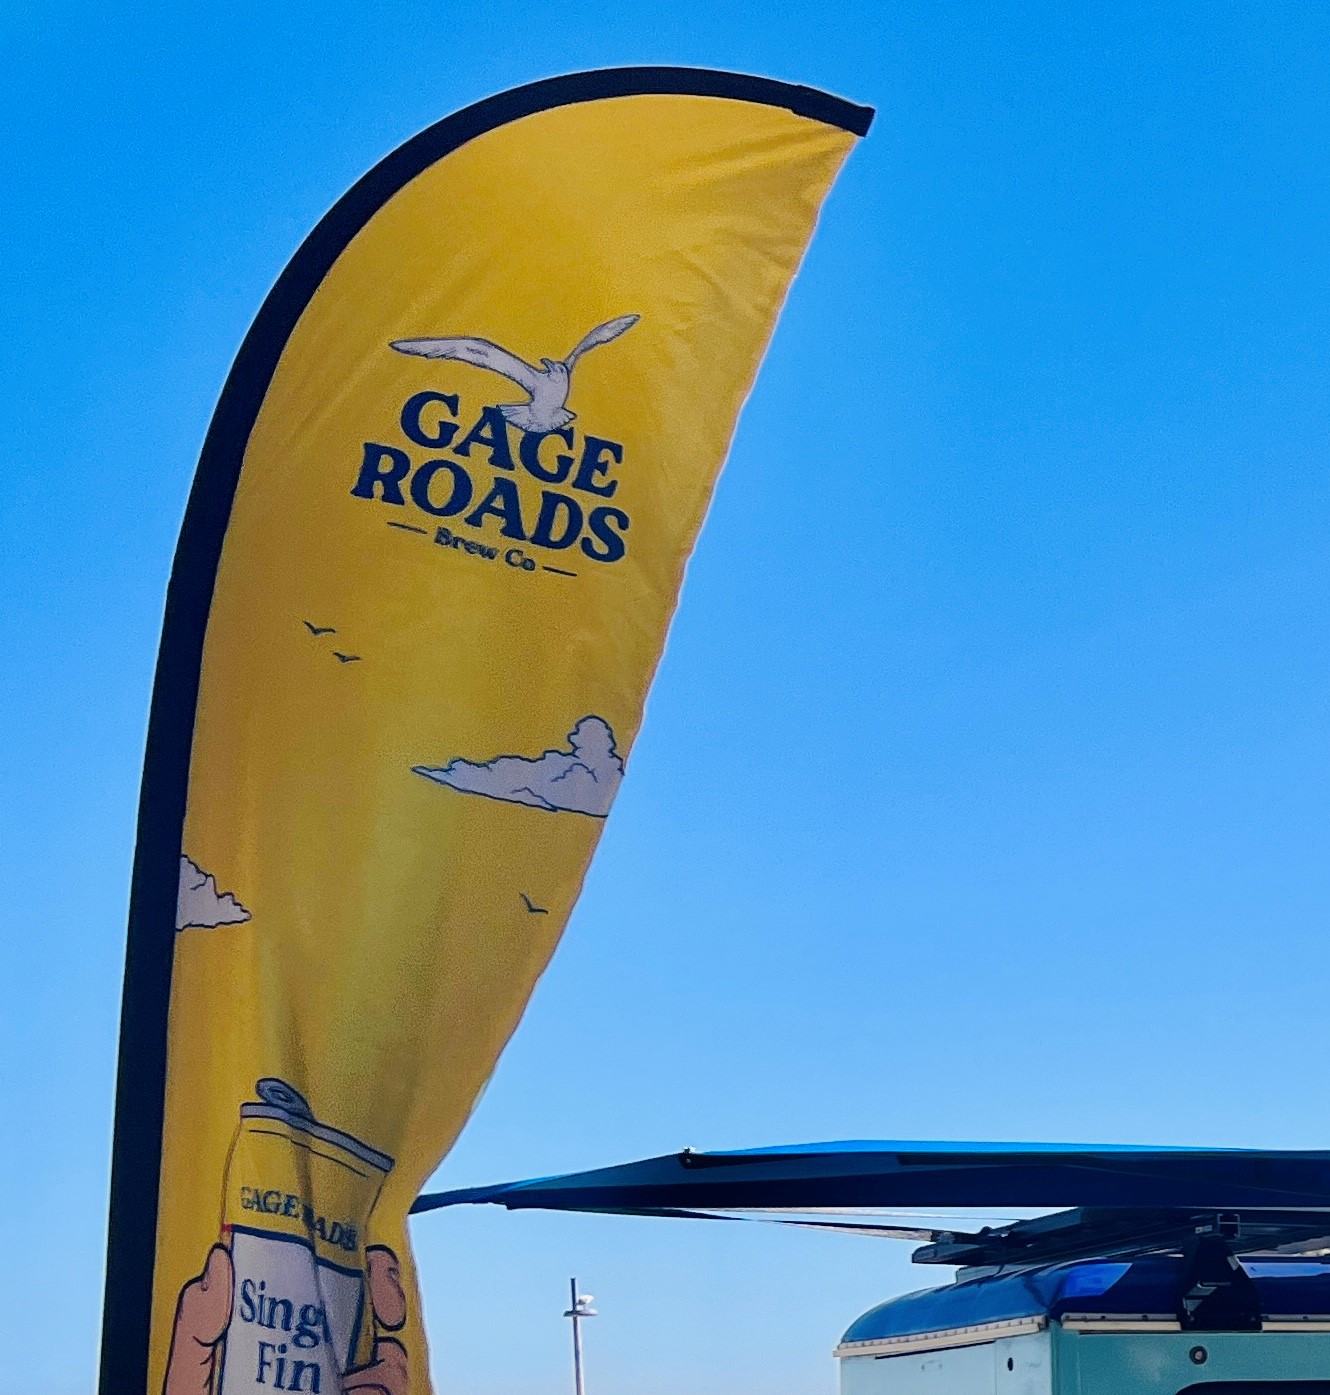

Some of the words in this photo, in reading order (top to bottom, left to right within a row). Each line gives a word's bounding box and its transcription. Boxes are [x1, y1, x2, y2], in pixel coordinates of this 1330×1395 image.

[400, 391, 624, 498] GAGE
[350, 442, 630, 563] ROADS
[434, 525, 498, 560] Brew
[239, 1277, 331, 1350] Sing
[255, 1340, 321, 1395] Fin
